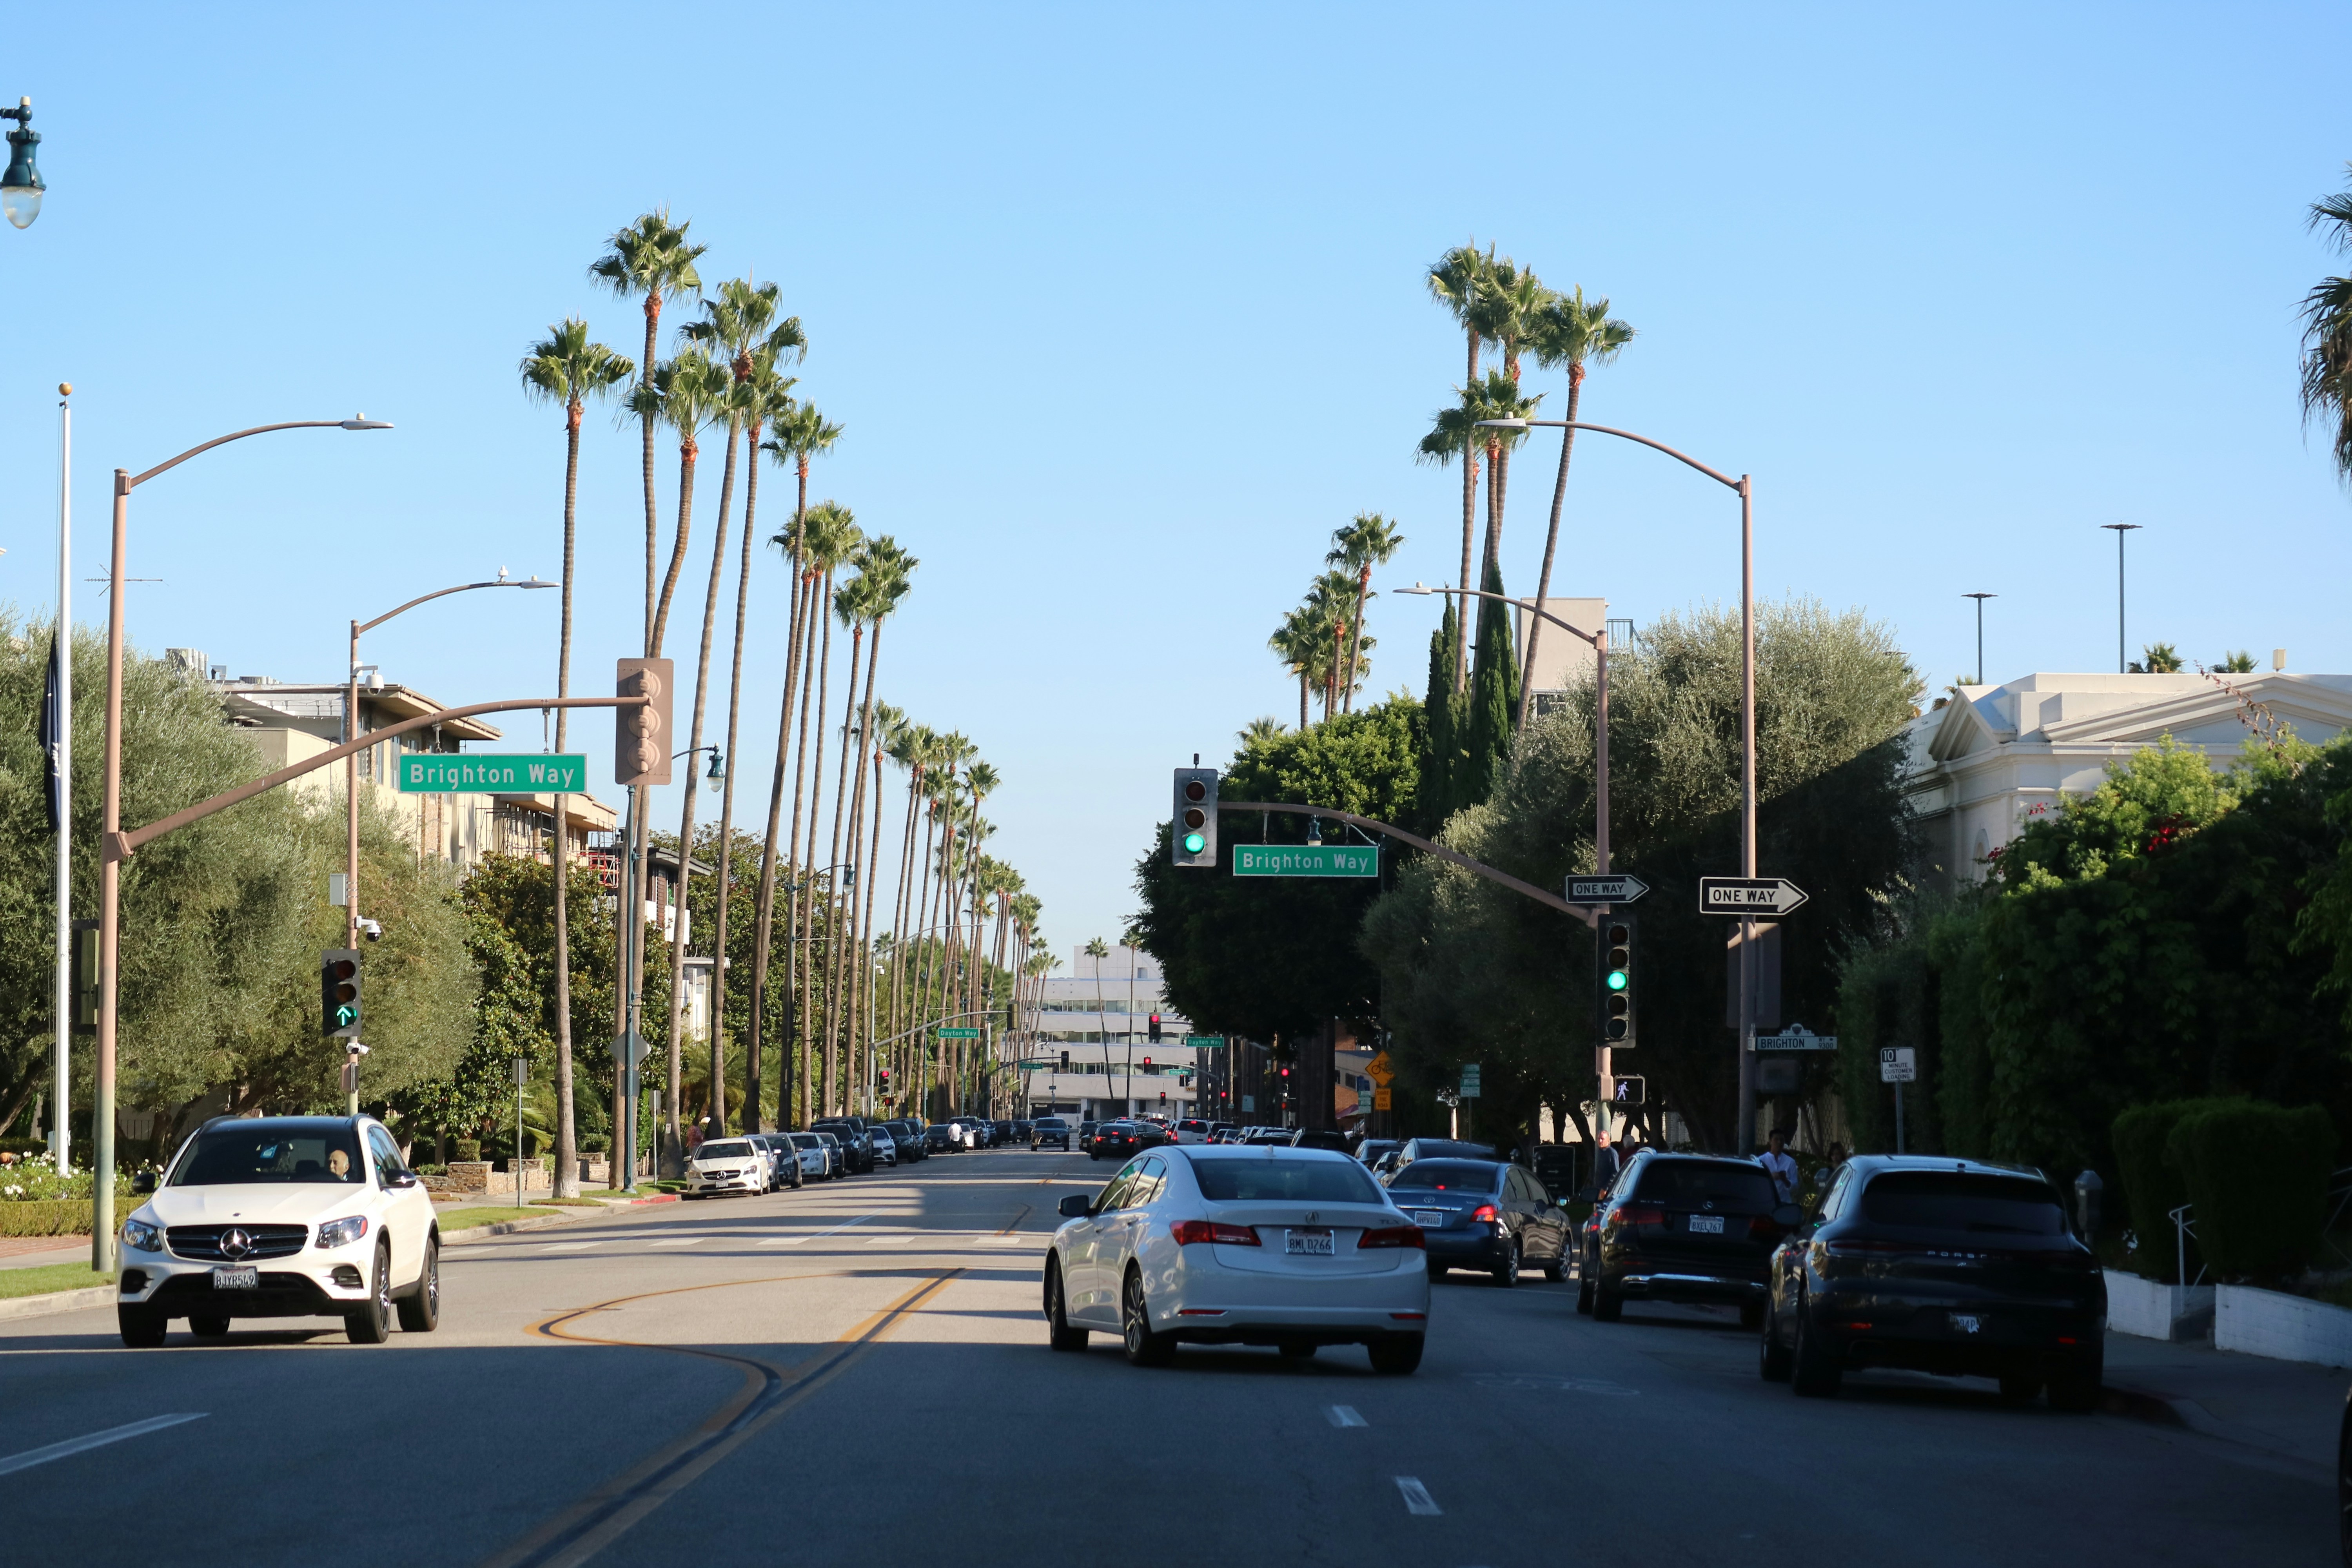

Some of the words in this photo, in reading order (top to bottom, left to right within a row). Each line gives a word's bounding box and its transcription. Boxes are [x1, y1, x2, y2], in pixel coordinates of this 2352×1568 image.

[410, 764, 514, 790] Brighton
[528, 764, 574, 788] Way
[1243, 853, 1323, 873] Brighton
[1334, 854, 1368, 873] Way
[1576, 883, 1598, 894] ONE
[1602, 884, 1624, 894] WAY
[1713, 890, 1741, 902] ONE
[1747, 891, 1776, 903] WAY
[1761, 1038, 1805, 1048] BRIGHTON
[1884, 1050, 1894, 1061] 10
[1692, 1221, 1721, 1231] 8XEL767
[1289, 1238, 1331, 1250] 8MLD266
[217, 1275, 254, 1286] 8JYR549
